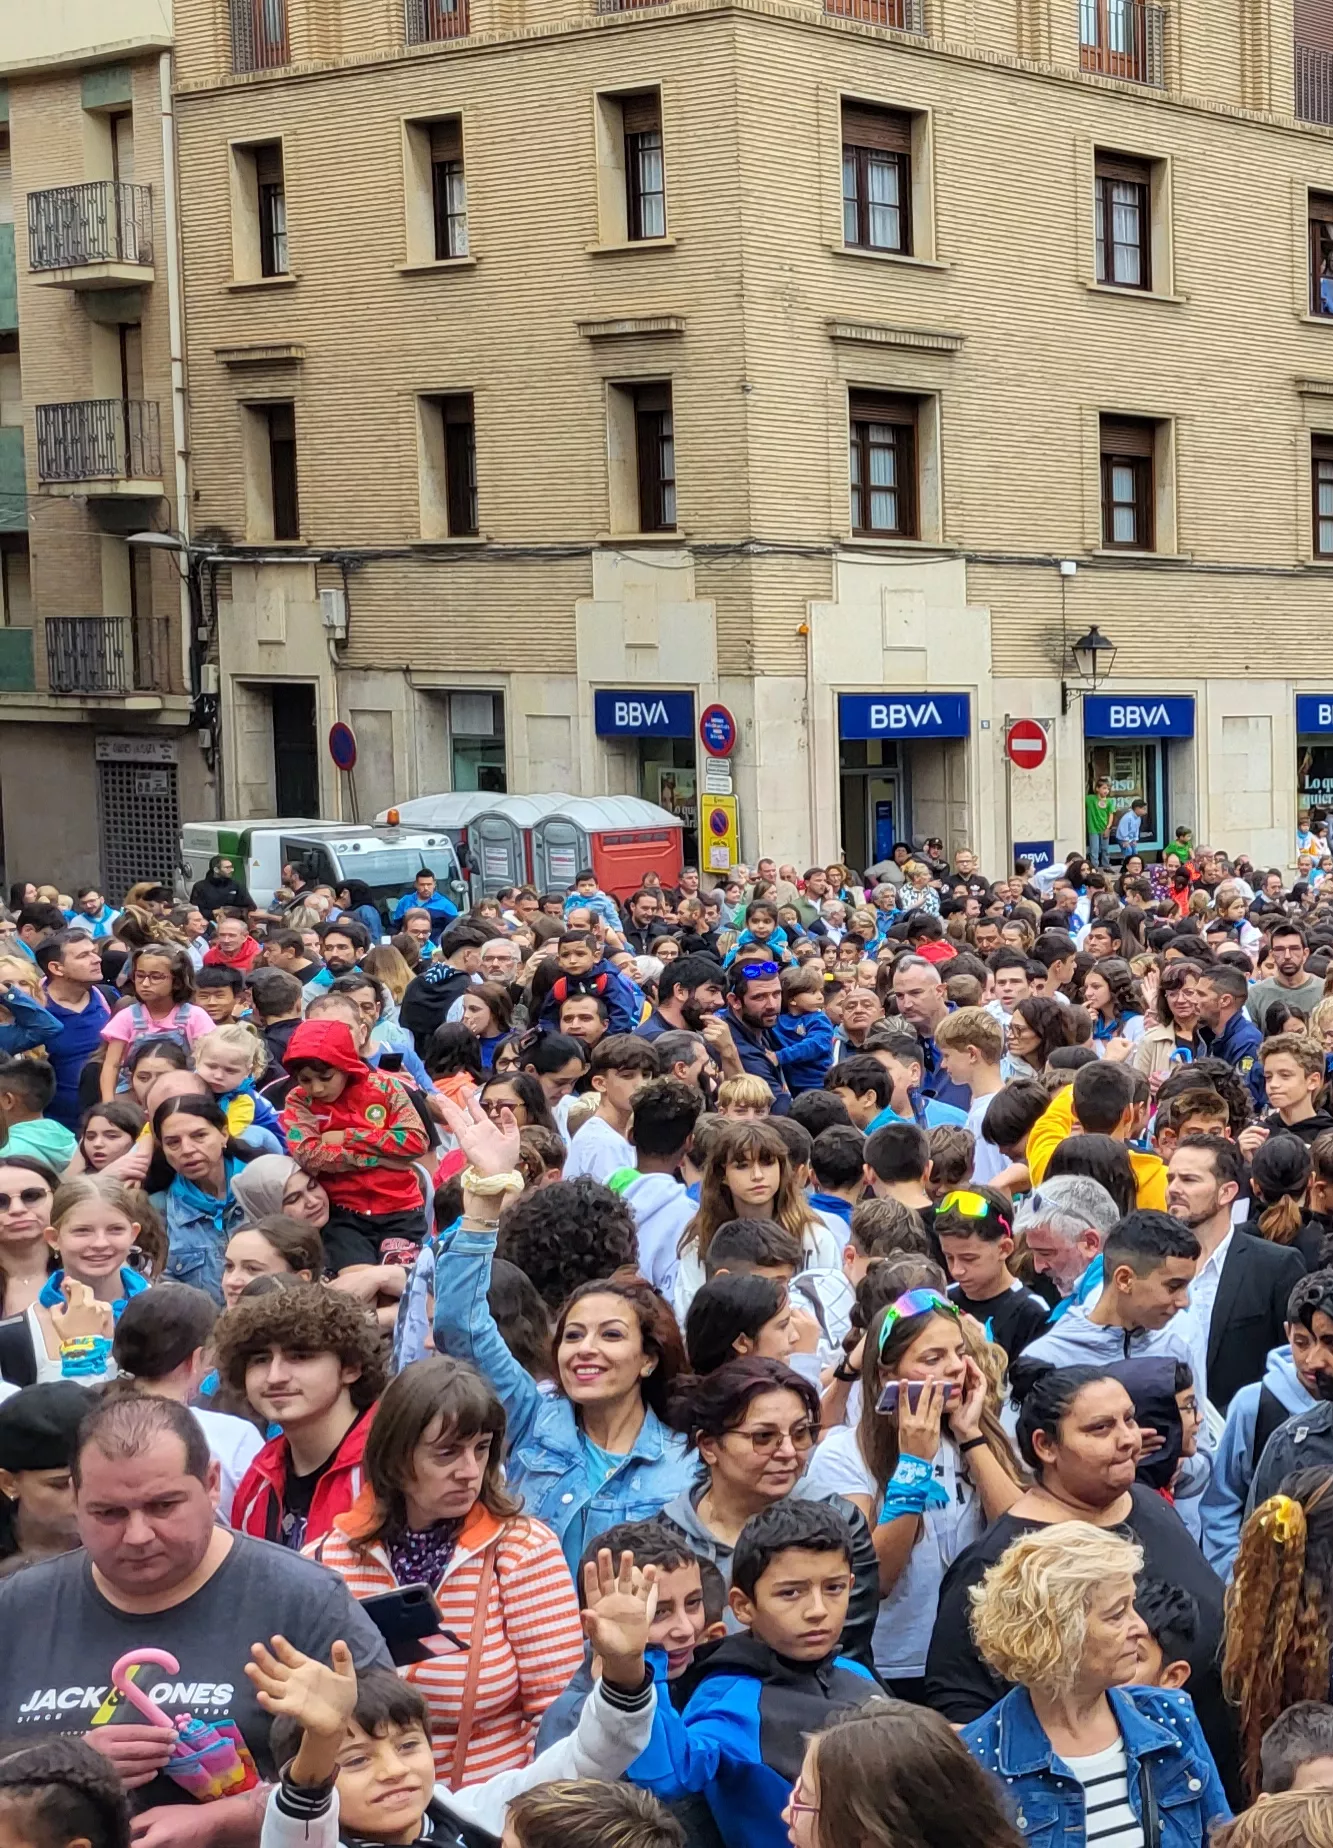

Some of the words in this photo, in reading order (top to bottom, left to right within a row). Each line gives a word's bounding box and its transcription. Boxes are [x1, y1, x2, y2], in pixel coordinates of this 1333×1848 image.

[615, 700, 669, 726] BBVA
[870, 700, 942, 729] BBVA
[1110, 703, 1171, 728] BBVA
[1304, 774, 1321, 789] Lo
[20, 1686, 108, 1712] JACK
[148, 1682, 235, 1706] ONES
[17, 1712, 63, 1724] SINCE
